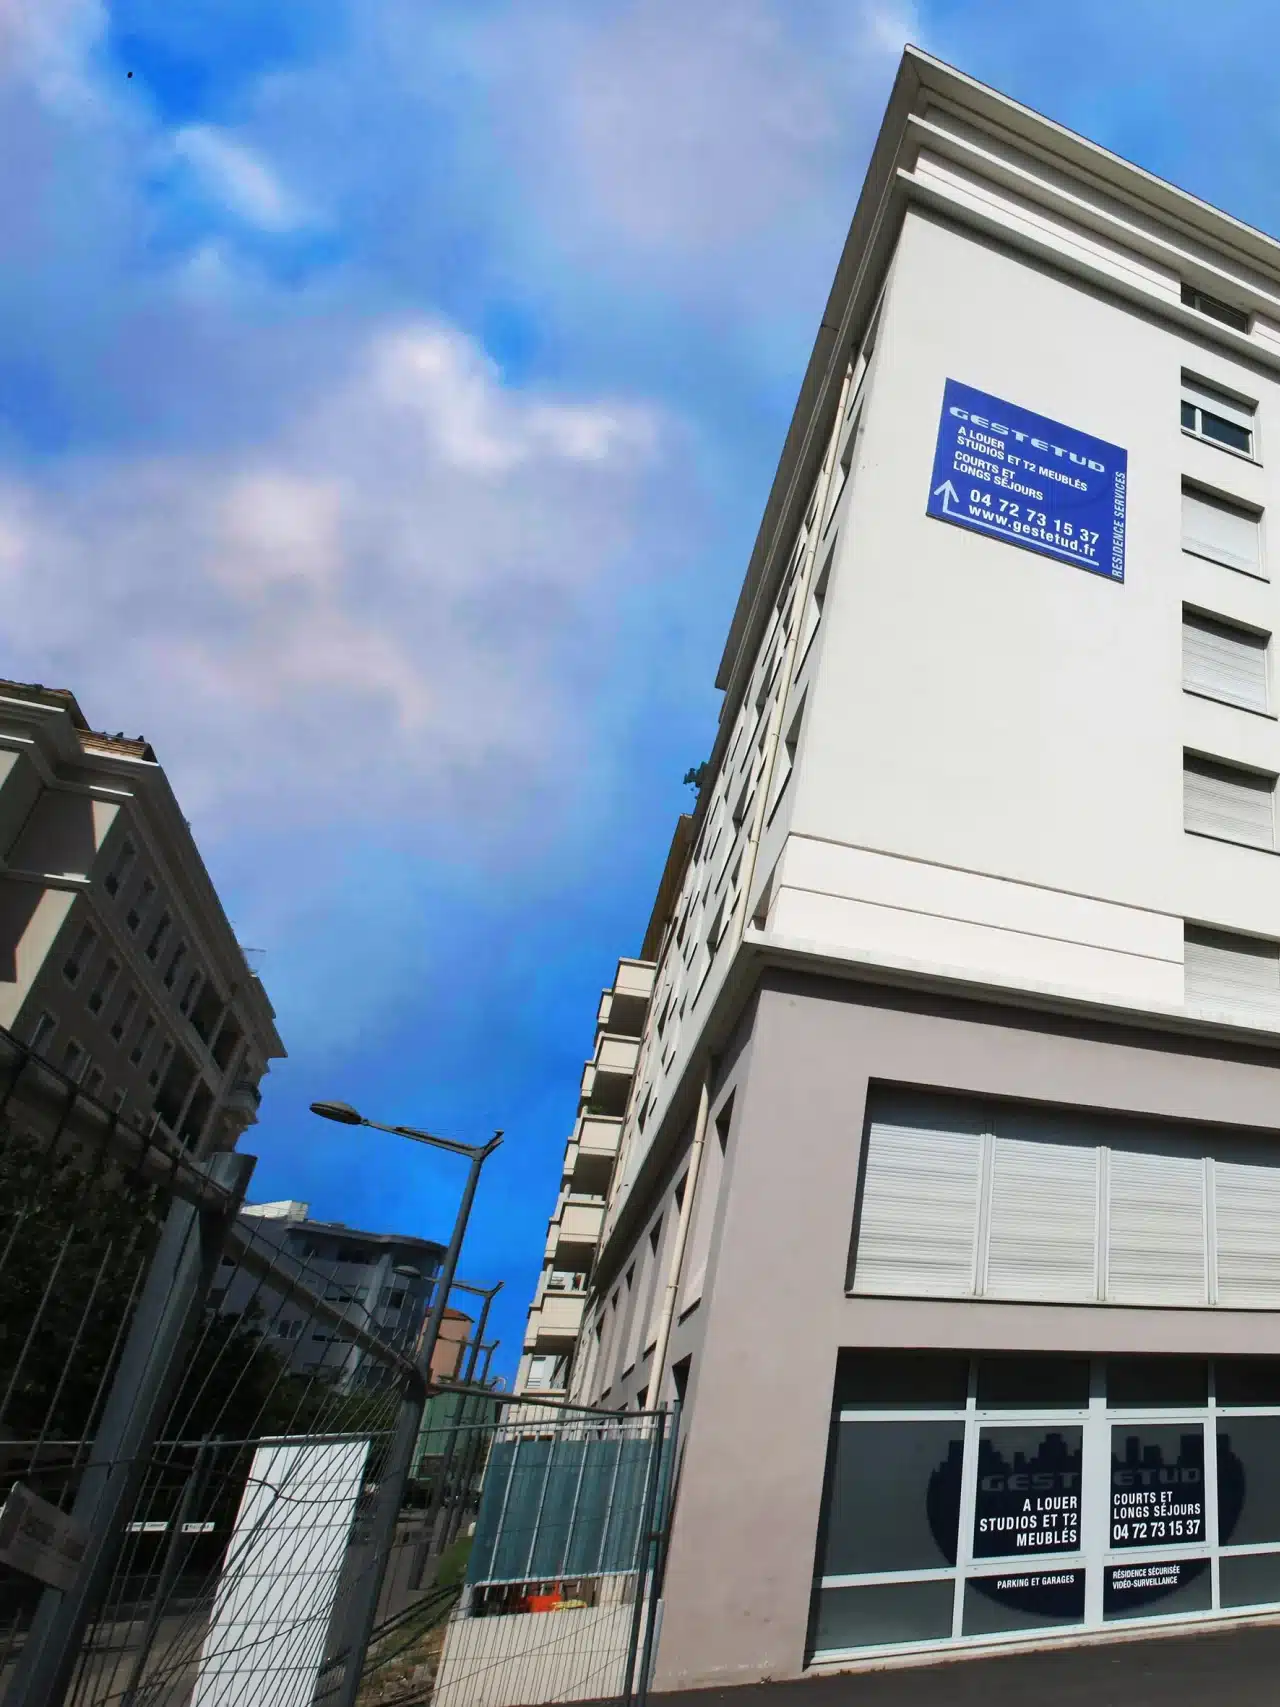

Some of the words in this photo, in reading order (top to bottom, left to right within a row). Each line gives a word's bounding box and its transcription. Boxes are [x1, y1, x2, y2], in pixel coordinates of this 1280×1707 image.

[949, 406, 1105, 473] GESTETUD
[958, 426, 967, 436] A
[969, 430, 1005, 450] LOUER
[954, 451, 999, 474] COURTS
[1001, 467, 1016, 480] ET
[957, 436, 1005, 460] STUDIOS
[1007, 454, 1022, 466] ET
[1023, 460, 1036, 472] T2
[1038, 466, 1088, 492] MEUBLÉS
[953, 460, 991, 481] LONGS
[993, 476, 1044, 501] SÉJOURS
[1113, 471, 1126, 517] SERVICES
[970, 489, 992, 507] 04
[998, 498, 1020, 517] 72
[1026, 508, 1047, 527] 73
[1053, 519, 1073, 536] 15
[1079, 528, 1100, 545] 37
[968, 504, 1096, 557] www.gestetud.fr
[1111, 519, 1124, 578] RESIDENCE
[1022, 1498, 1032, 1512] A
[1036, 1496, 1078, 1511] LOUER
[1113, 1491, 1157, 1505] COURTS
[1160, 1491, 1173, 1503] ET
[1113, 1504, 1150, 1520] LONGS
[1153, 1502, 1201, 1517] SÉJOURS
[979, 1515, 1038, 1532] STUDIOS
[1042, 1514, 1058, 1528] ET
[1062, 1513, 1078, 1526] T2
[1113, 1523, 1128, 1540] 04
[1132, 1522, 1147, 1539] 72
[1150, 1521, 1166, 1538] 73
[1168, 1520, 1182, 1536] 15
[1186, 1519, 1201, 1535] 37
[1016, 1528, 1077, 1547] MEUBLÉS
[997, 1578, 1029, 1590] PARKING
[1031, 1577, 1040, 1587] ET
[1041, 1575, 1075, 1586] GARAGES
[1112, 1567, 1147, 1580] RÉSIDENCE
[1147, 1564, 1181, 1576] SÉCURISÉE
[1112, 1575, 1178, 1590] VIDÉO-SURVEILLANCE
